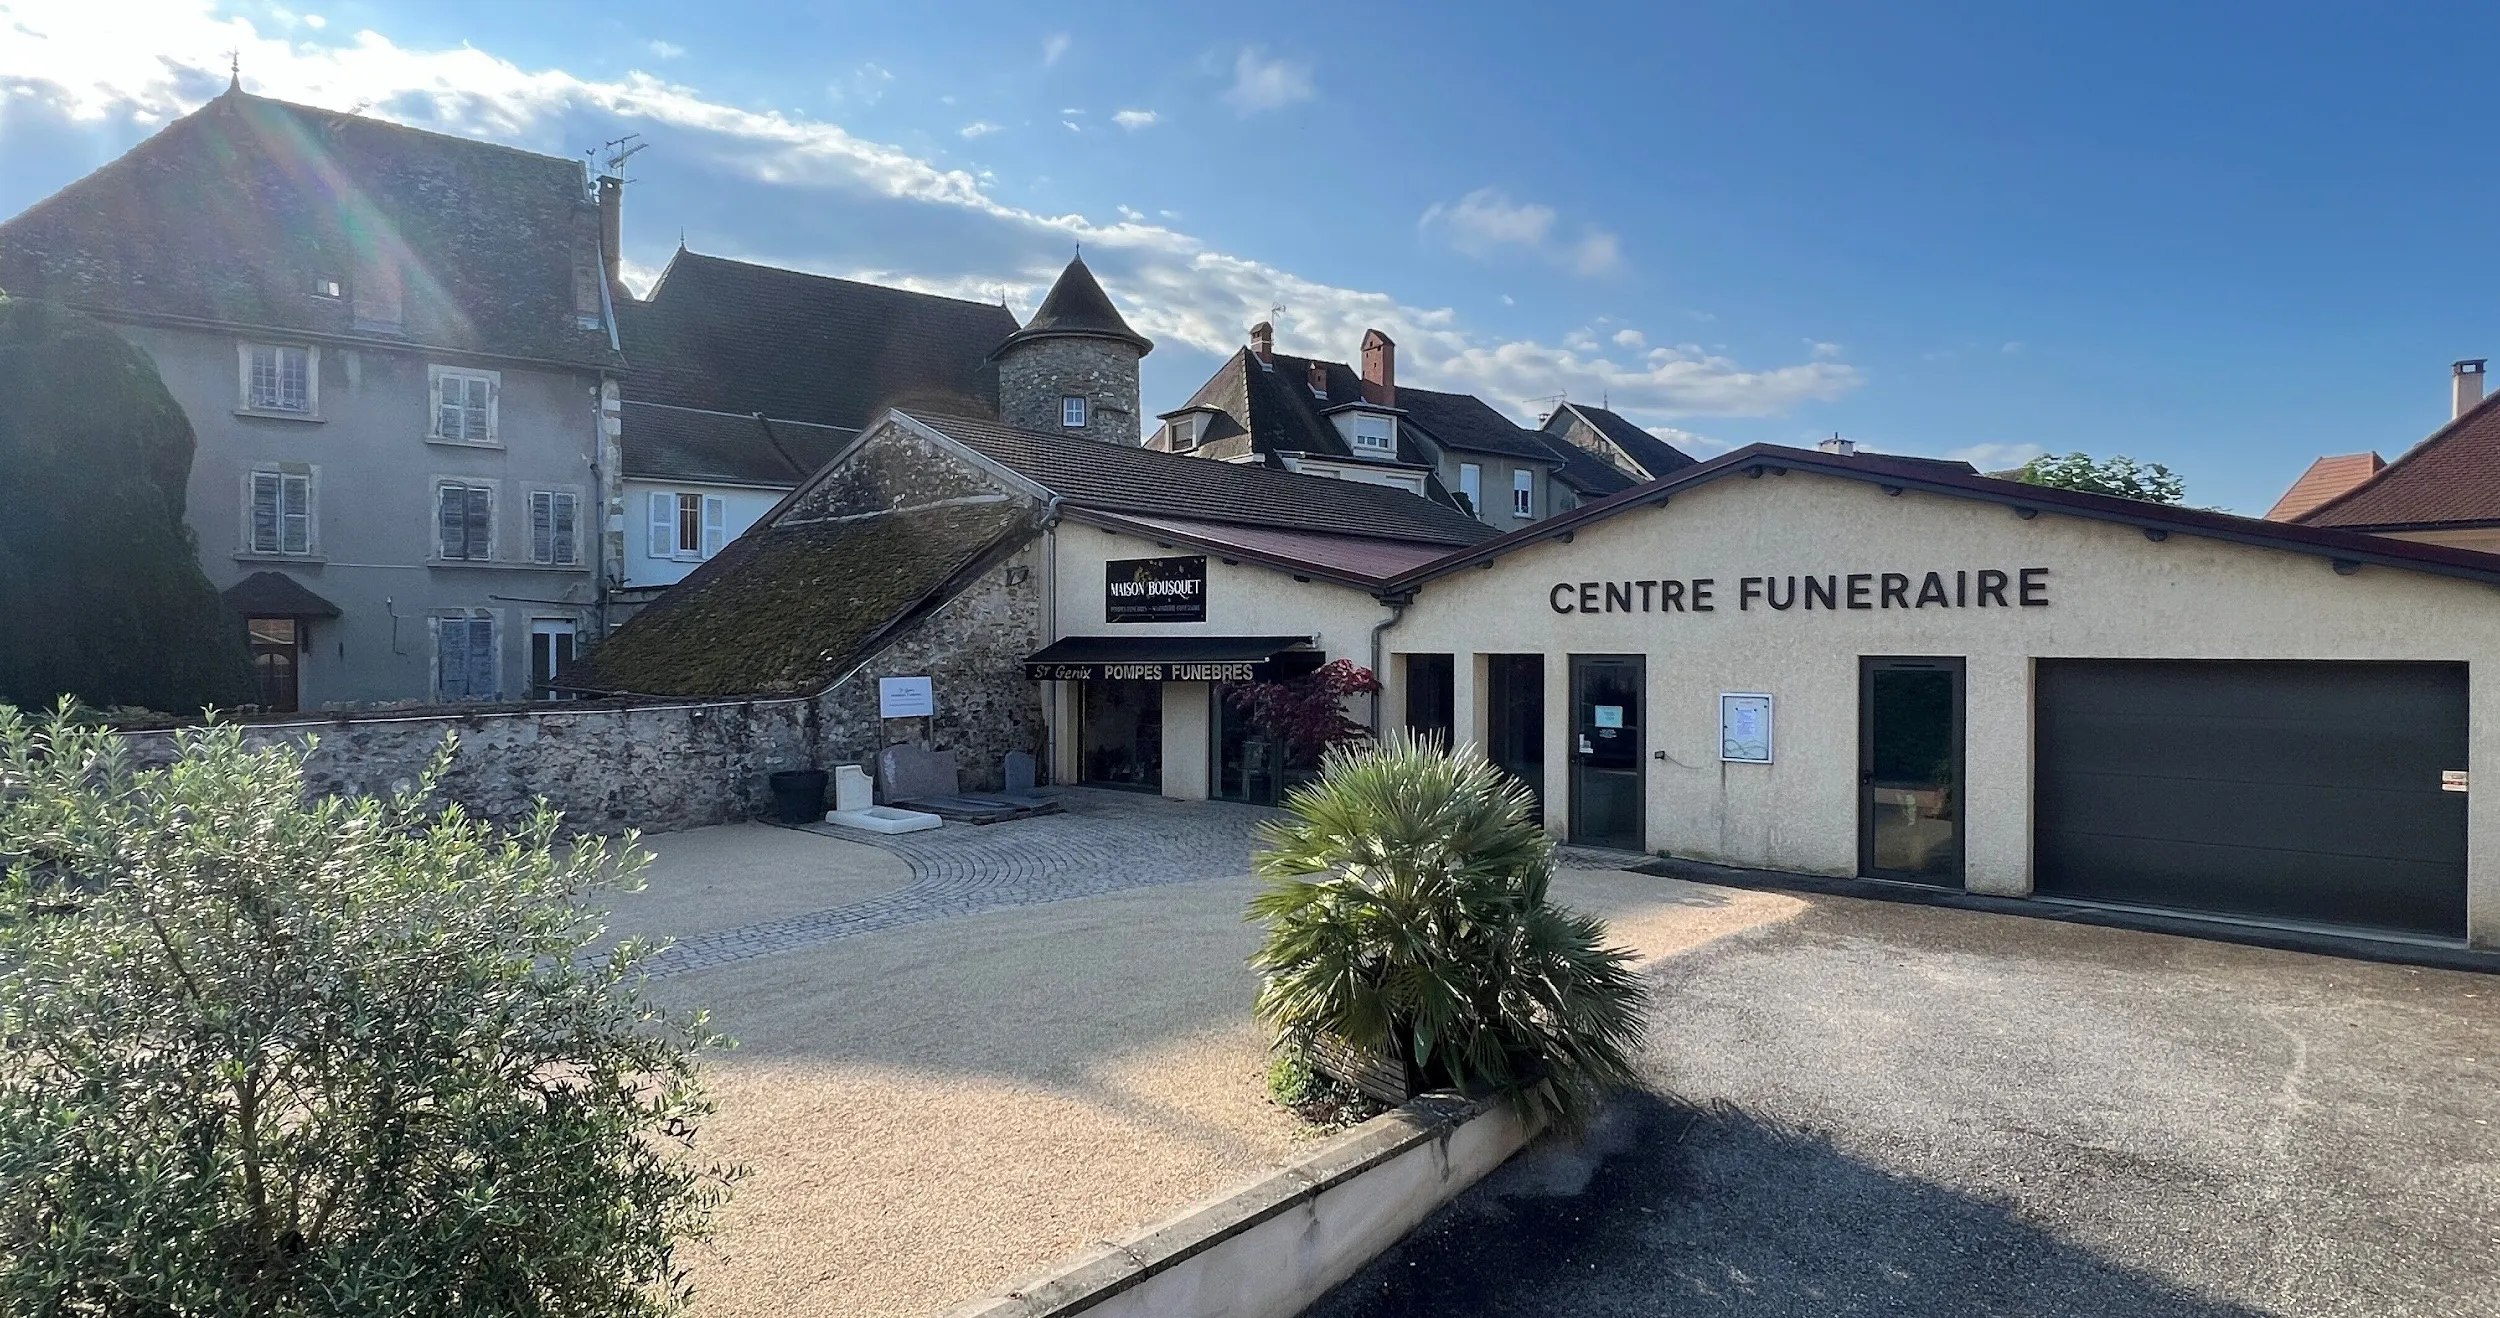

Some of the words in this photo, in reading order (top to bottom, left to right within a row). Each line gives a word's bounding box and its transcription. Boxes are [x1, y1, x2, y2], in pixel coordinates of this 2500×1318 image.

[1110, 582, 1144, 597] MAISON
[1149, 579, 1201, 600] BOUSQUET
[1549, 578, 1714, 615] CENTRE
[1740, 567, 2049, 611] FUNERAIRE
[1055, 664, 1092, 679] Genix
[1104, 664, 1162, 680] POMPES
[1172, 663, 1254, 681] FUNEBRES
